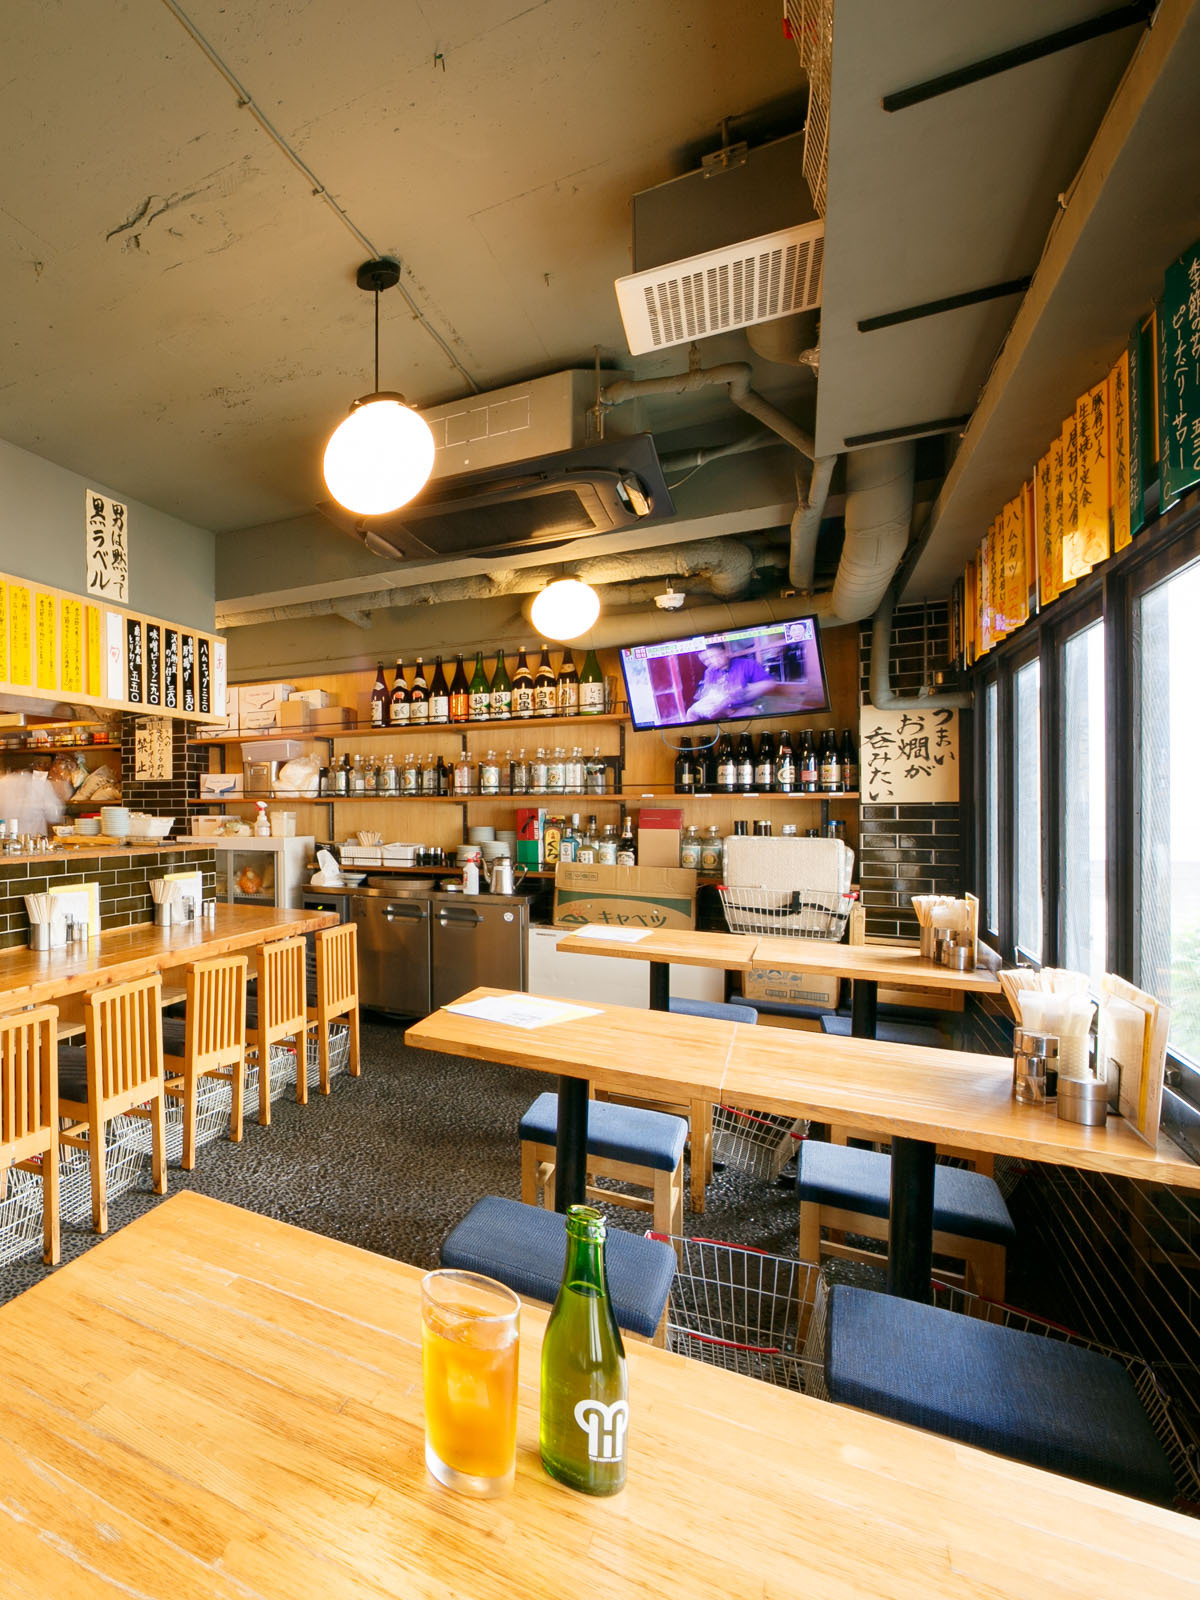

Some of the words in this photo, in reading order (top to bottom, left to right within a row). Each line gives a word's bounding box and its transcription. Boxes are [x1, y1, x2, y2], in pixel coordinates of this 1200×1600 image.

[89, 496, 111, 591] 黒ラベル
[111, 503, 128, 599] 男は黙って
[862, 726, 897, 802] 呑みたい
[895, 713, 936, 780] お燗が
[597, 910, 667, 928] キャベツ
